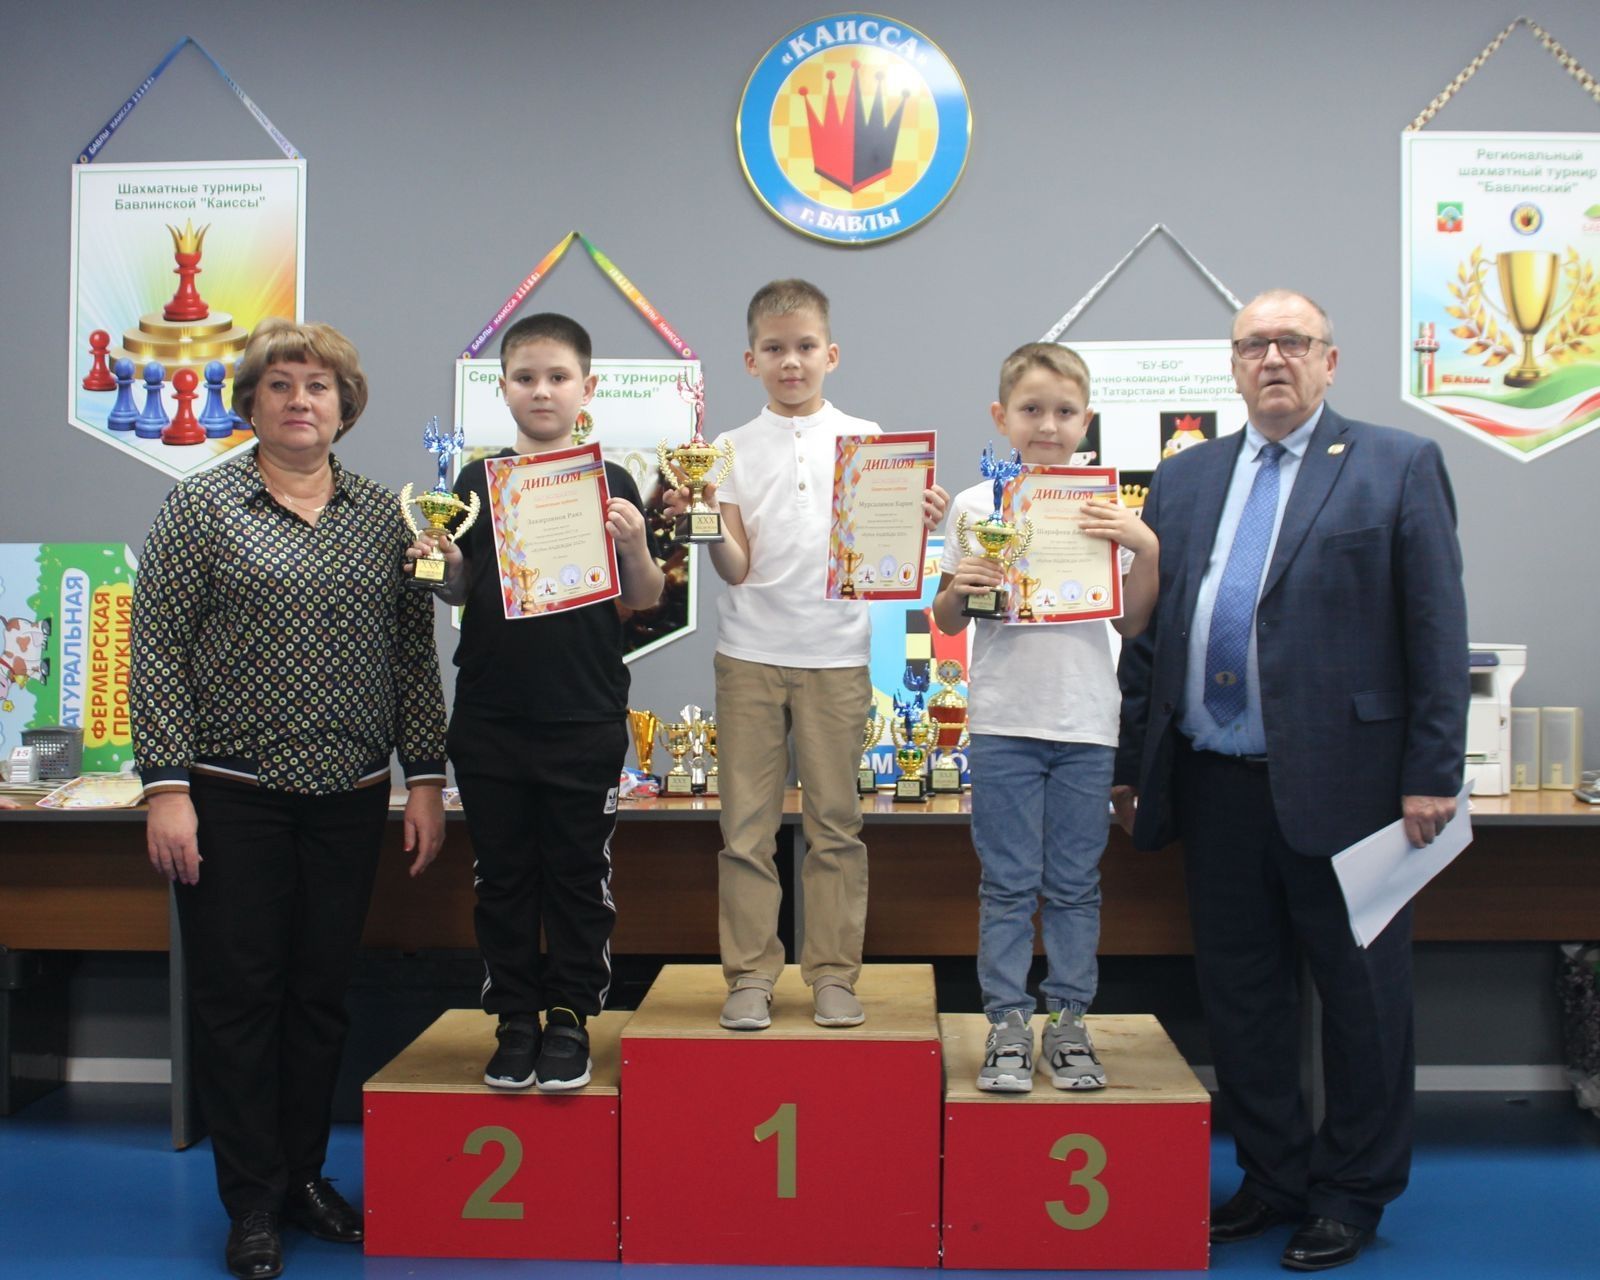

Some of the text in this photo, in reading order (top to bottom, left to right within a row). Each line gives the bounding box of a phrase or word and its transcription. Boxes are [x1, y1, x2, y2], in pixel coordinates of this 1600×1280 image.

[1476, 148, 1583, 160] Региональный
[1458, 166, 1598, 179] шахматный турнир
[118, 182, 262, 195] Шахматные турниры
[115, 196, 265, 210] Бавлинской "Каиссы"
[817, 207, 900, 232] БАВЛЫ
[471, 298, 517, 350] БАВЛЫ КАИССА
[1102, 386, 1165, 397] Татарстана
[1168, 387, 1175, 395] и
[862, 458, 915, 472] ДИПЛОМ
[521, 470, 581, 492] ДИПЛОМ
[1032, 489, 1094, 501] ДИПЛОМ
[62, 576, 83, 729] АТУРАЛЬНАЯ
[91, 592, 111, 739] ФЕРМЕРСКАЯ
[113, 595, 132, 736] ПРОДУКЦИЯ
[754, 1103, 796, 1198] 1
[462, 1126, 524, 1219] 2
[1045, 1133, 1109, 1230] 3
